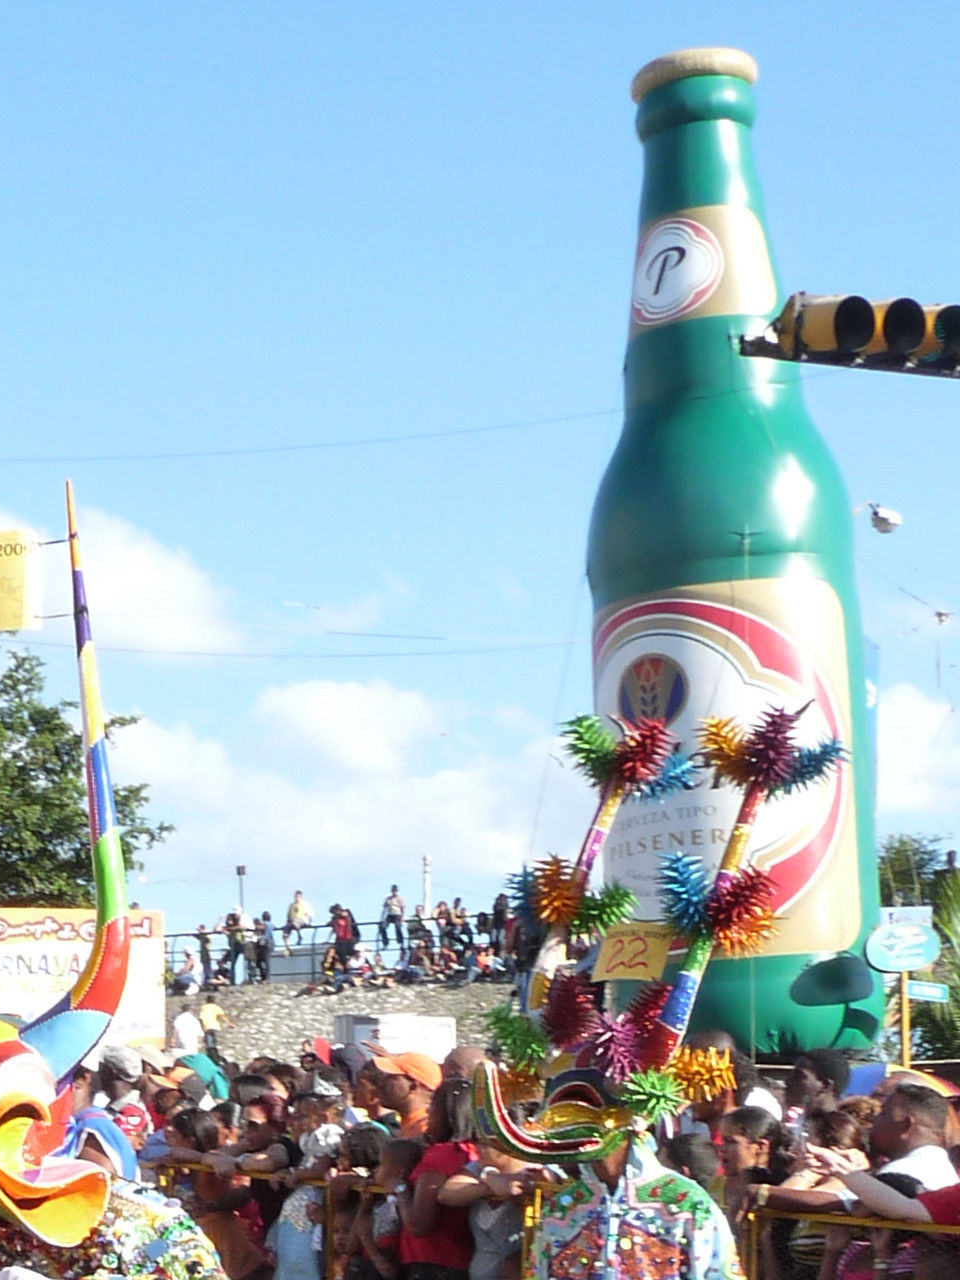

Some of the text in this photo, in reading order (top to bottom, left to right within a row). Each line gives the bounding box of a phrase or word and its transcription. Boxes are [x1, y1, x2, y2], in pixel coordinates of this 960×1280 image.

[645, 245, 686, 295] P
[675, 804, 718, 821] TIPO
[609, 827, 729, 863] PILSENER
[605, 935, 649, 974] 22
